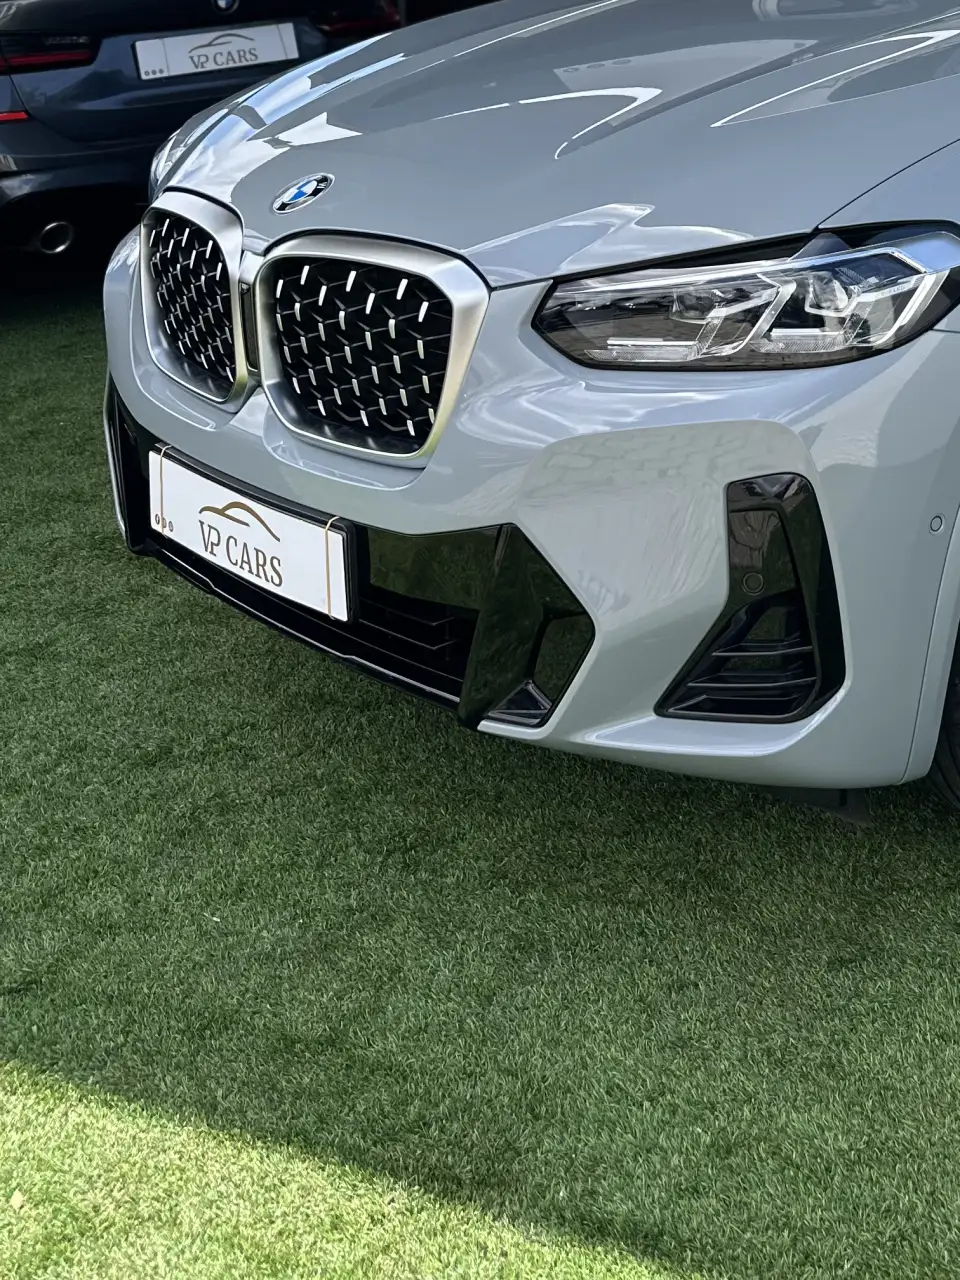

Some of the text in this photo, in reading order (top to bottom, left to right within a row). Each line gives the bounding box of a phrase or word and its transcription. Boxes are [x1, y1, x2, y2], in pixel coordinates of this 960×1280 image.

[188, 47, 259, 70] VP CARS
[198, 519, 284, 588] VP CARS
